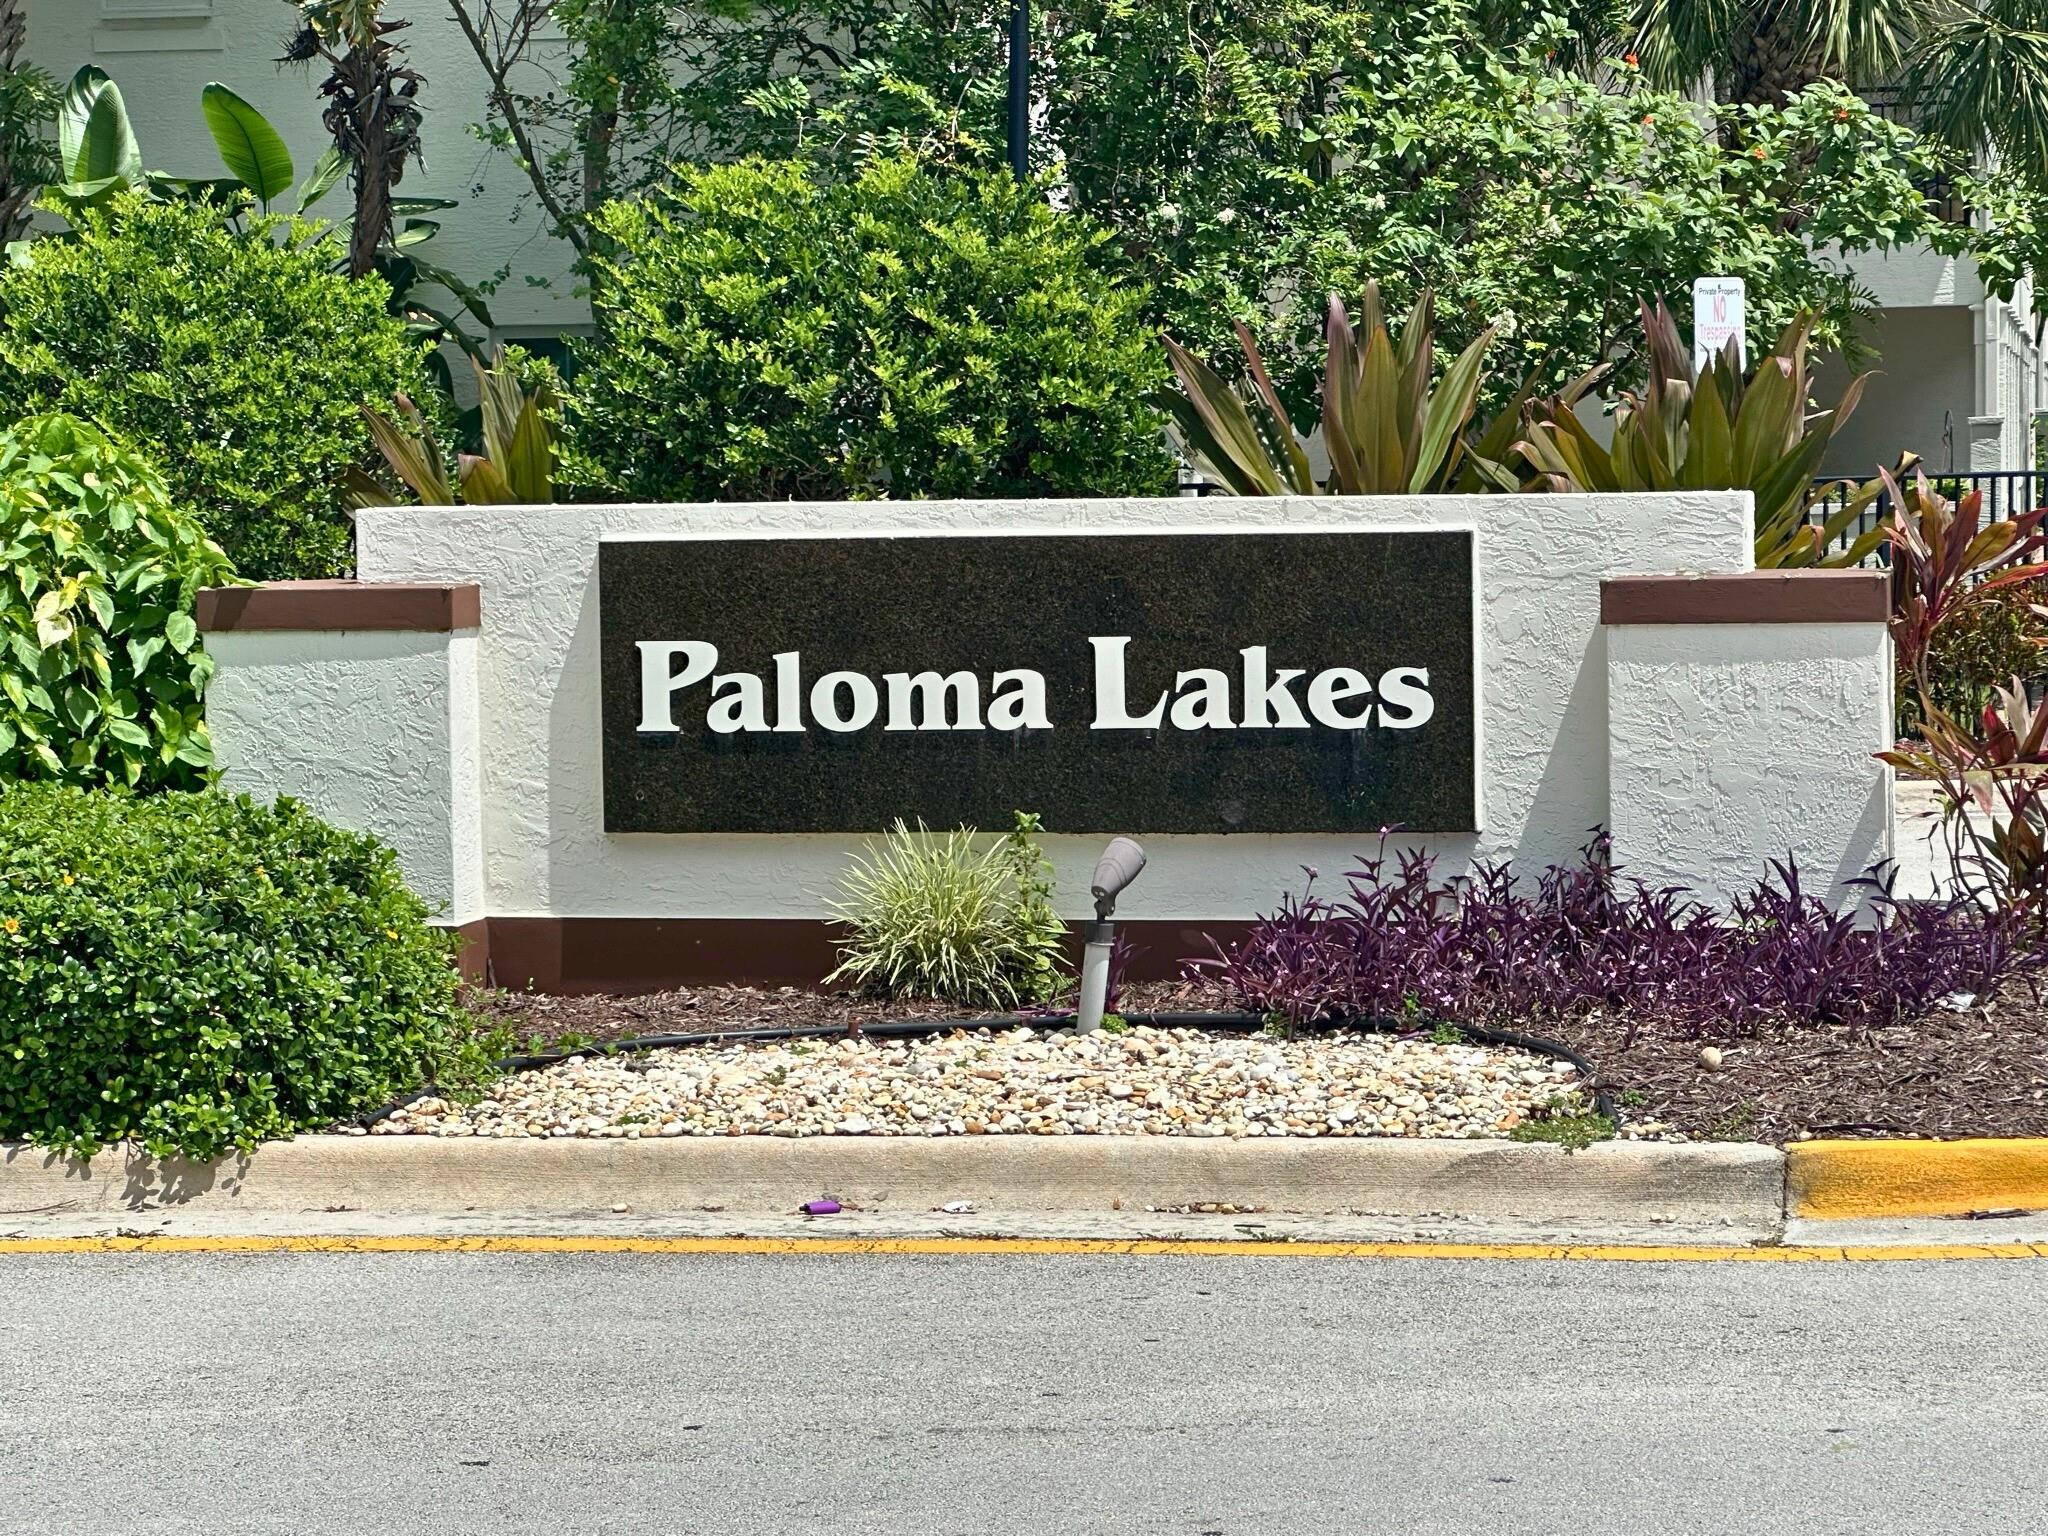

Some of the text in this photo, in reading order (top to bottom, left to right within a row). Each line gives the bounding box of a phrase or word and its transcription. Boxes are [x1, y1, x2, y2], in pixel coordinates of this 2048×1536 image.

[1698, 287, 1741, 297] Private Property
[1713, 295, 1727, 323] NO
[634, 634, 1436, 734] Paloma Lakes
